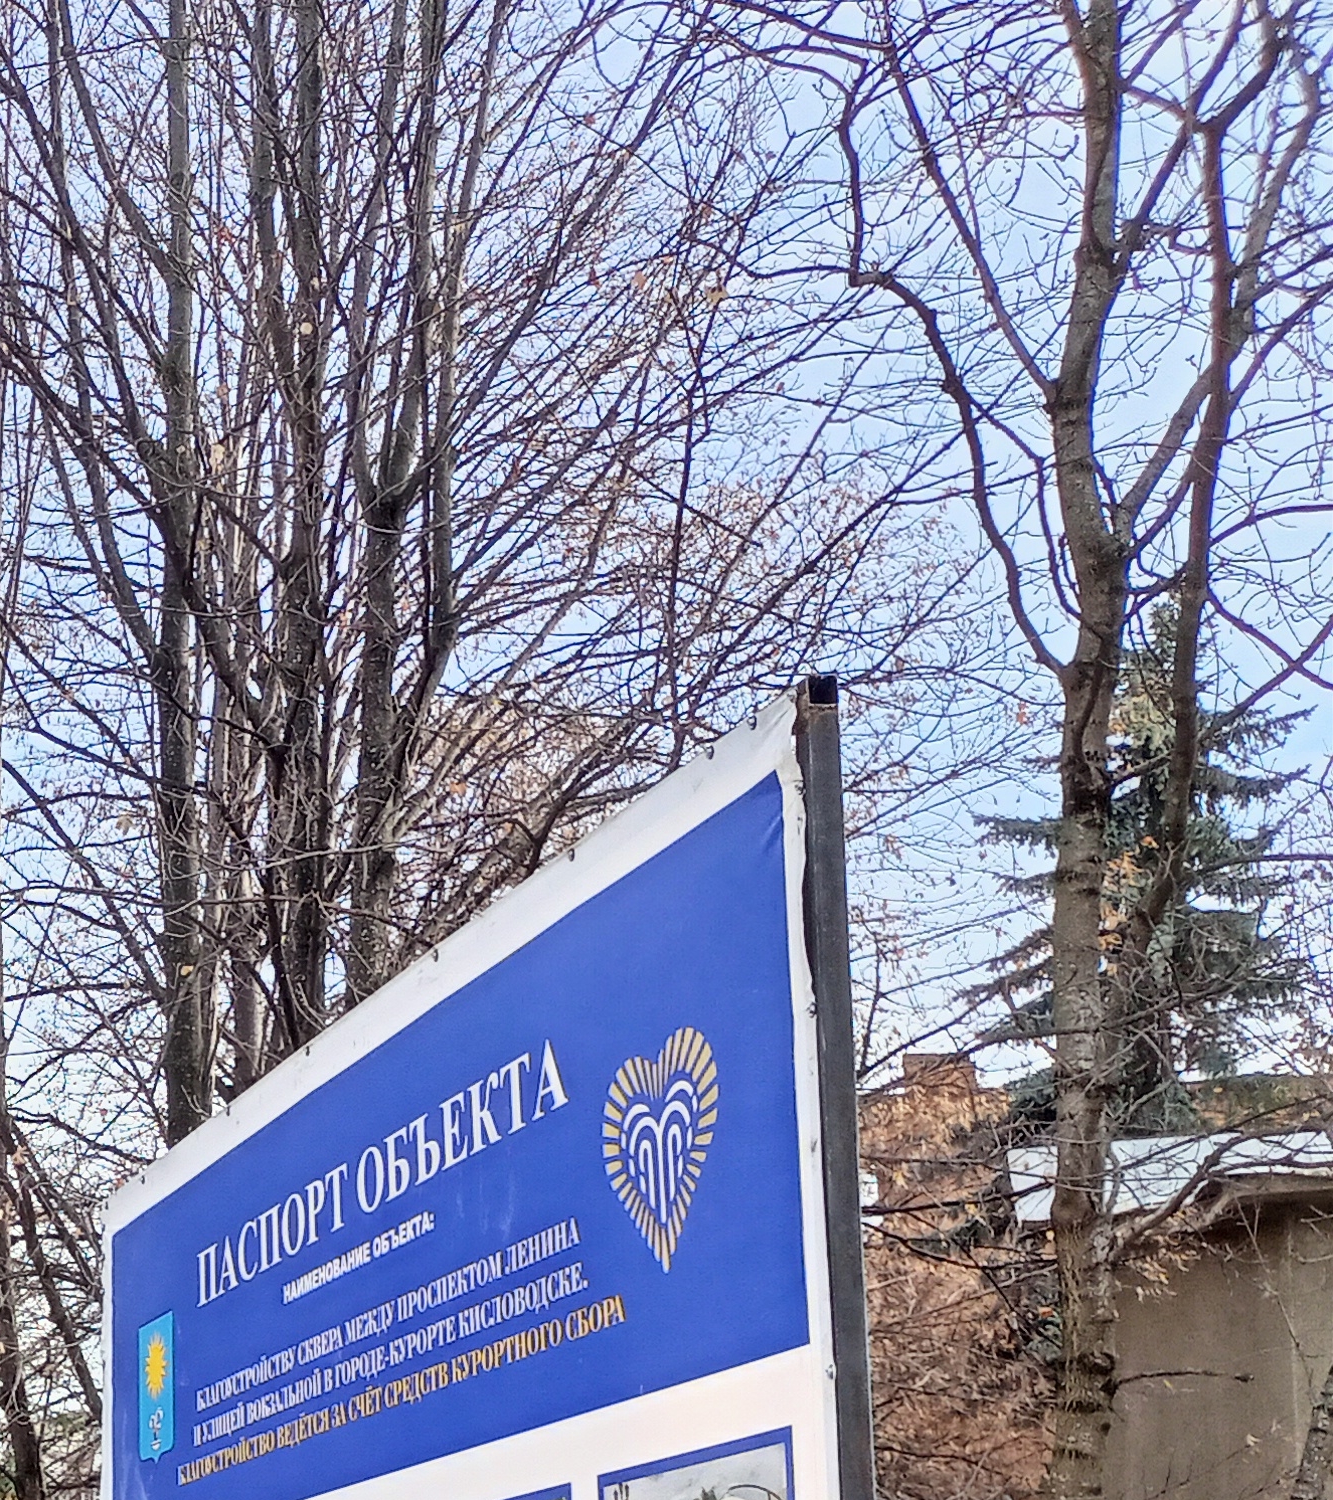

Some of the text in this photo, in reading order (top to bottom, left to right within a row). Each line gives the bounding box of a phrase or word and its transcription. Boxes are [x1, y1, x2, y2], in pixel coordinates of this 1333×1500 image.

[196, 1038, 569, 1307] ПАСПОРТ ОБЪЕКТА
[283, 1211, 435, 1304] НАИМЕНОВАНИЕ ОБЪЕКТА:
[193, 1262, 589, 1446] И УЛИЦЕЙ ВОКЗАЛЬНОЙ В ГОРОДЕ-КУРОРТЕ КИСЛОВОДСКЕ.
[297, 1325, 343, 1366] СКВЕРА
[344, 1299, 395, 1345] МЕЖДУ
[397, 1250, 503, 1323] ПРОСПЕКТОМ
[504, 1217, 581, 1274] ЛЕНИНА
[177, 1294, 626, 1486] БЛАГОУСТРОЙСТВО ВЕДЁТСЯ ЗА СЧЁТ СРЕДСТВ КУРОРТНОГО СБОРА
